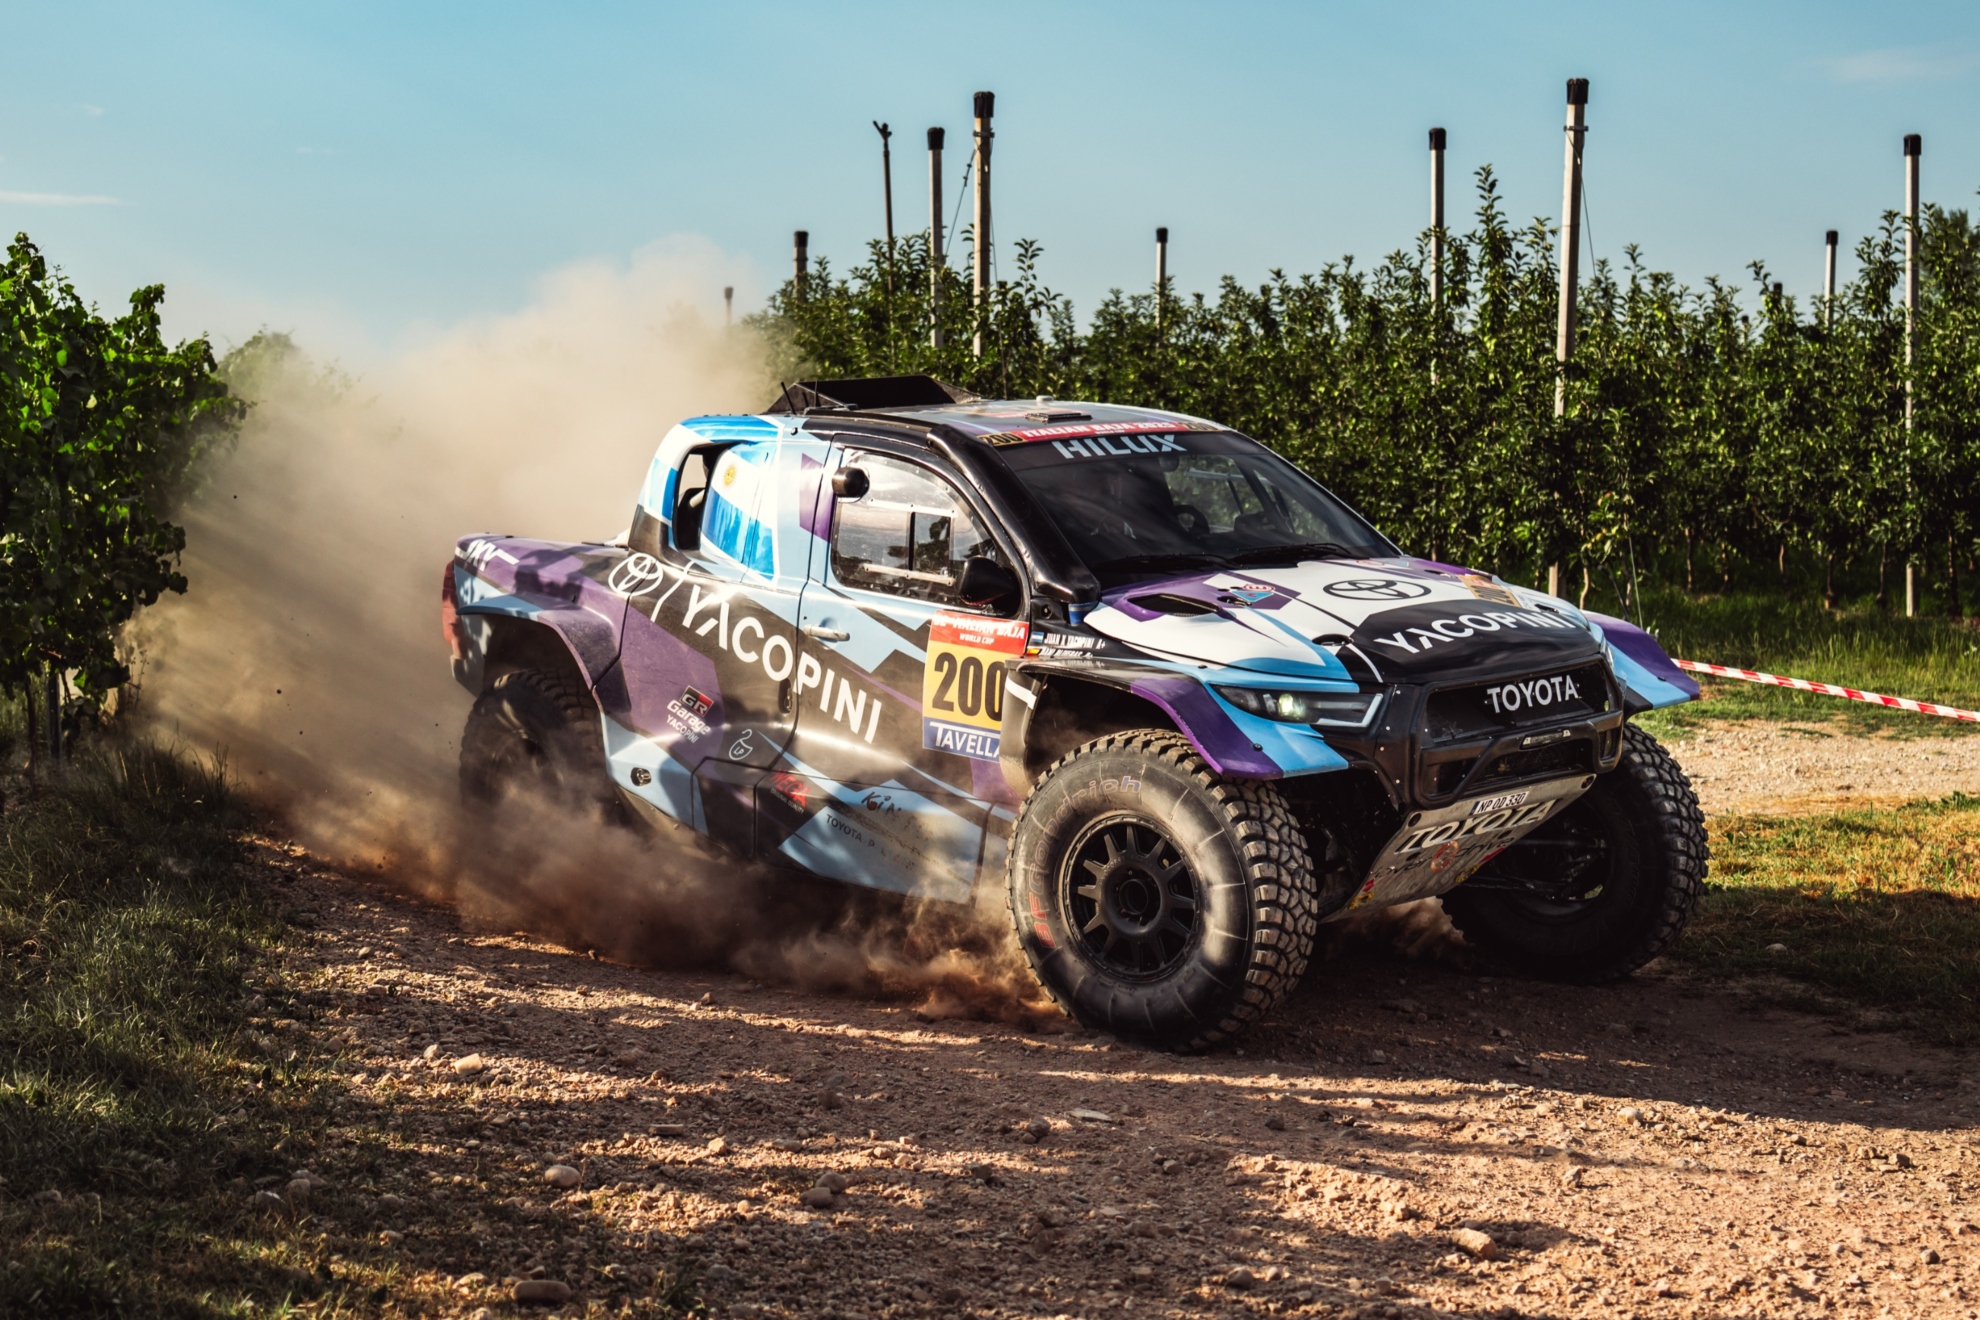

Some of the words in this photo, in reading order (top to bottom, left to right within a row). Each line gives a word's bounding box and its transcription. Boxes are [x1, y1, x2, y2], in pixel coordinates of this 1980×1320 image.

[985, 432, 1023, 446] 200
[1022, 424, 1087, 438] ITALIAN
[1092, 421, 1132, 431] BAJA
[1051, 434, 1188, 459] HILUX
[959, 632, 981, 643] WORLD
[981, 635, 995, 646] CUP
[996, 622, 1026, 640] BAJA
[1044, 633, 1061, 645] JUAN
[1060, 634, 1067, 645] X
[1066, 635, 1095, 648] YACOPINI
[1095, 638, 1106, 650] A+
[1373, 611, 1577, 655] YACOPINI
[681, 584, 882, 744] YACOPINI
[931, 651, 1005, 722] 200
[1486, 674, 1579, 714] TOYOTA
[666, 699, 712, 736] Garage
[681, 693, 709, 715] GR
[666, 714, 700, 744] YACOPINI
[1476, 800, 1493, 813] NP
[1505, 792, 1527, 807] 330
[826, 813, 863, 844] TOYOTA
[1395, 799, 1559, 855] TOYOTA
